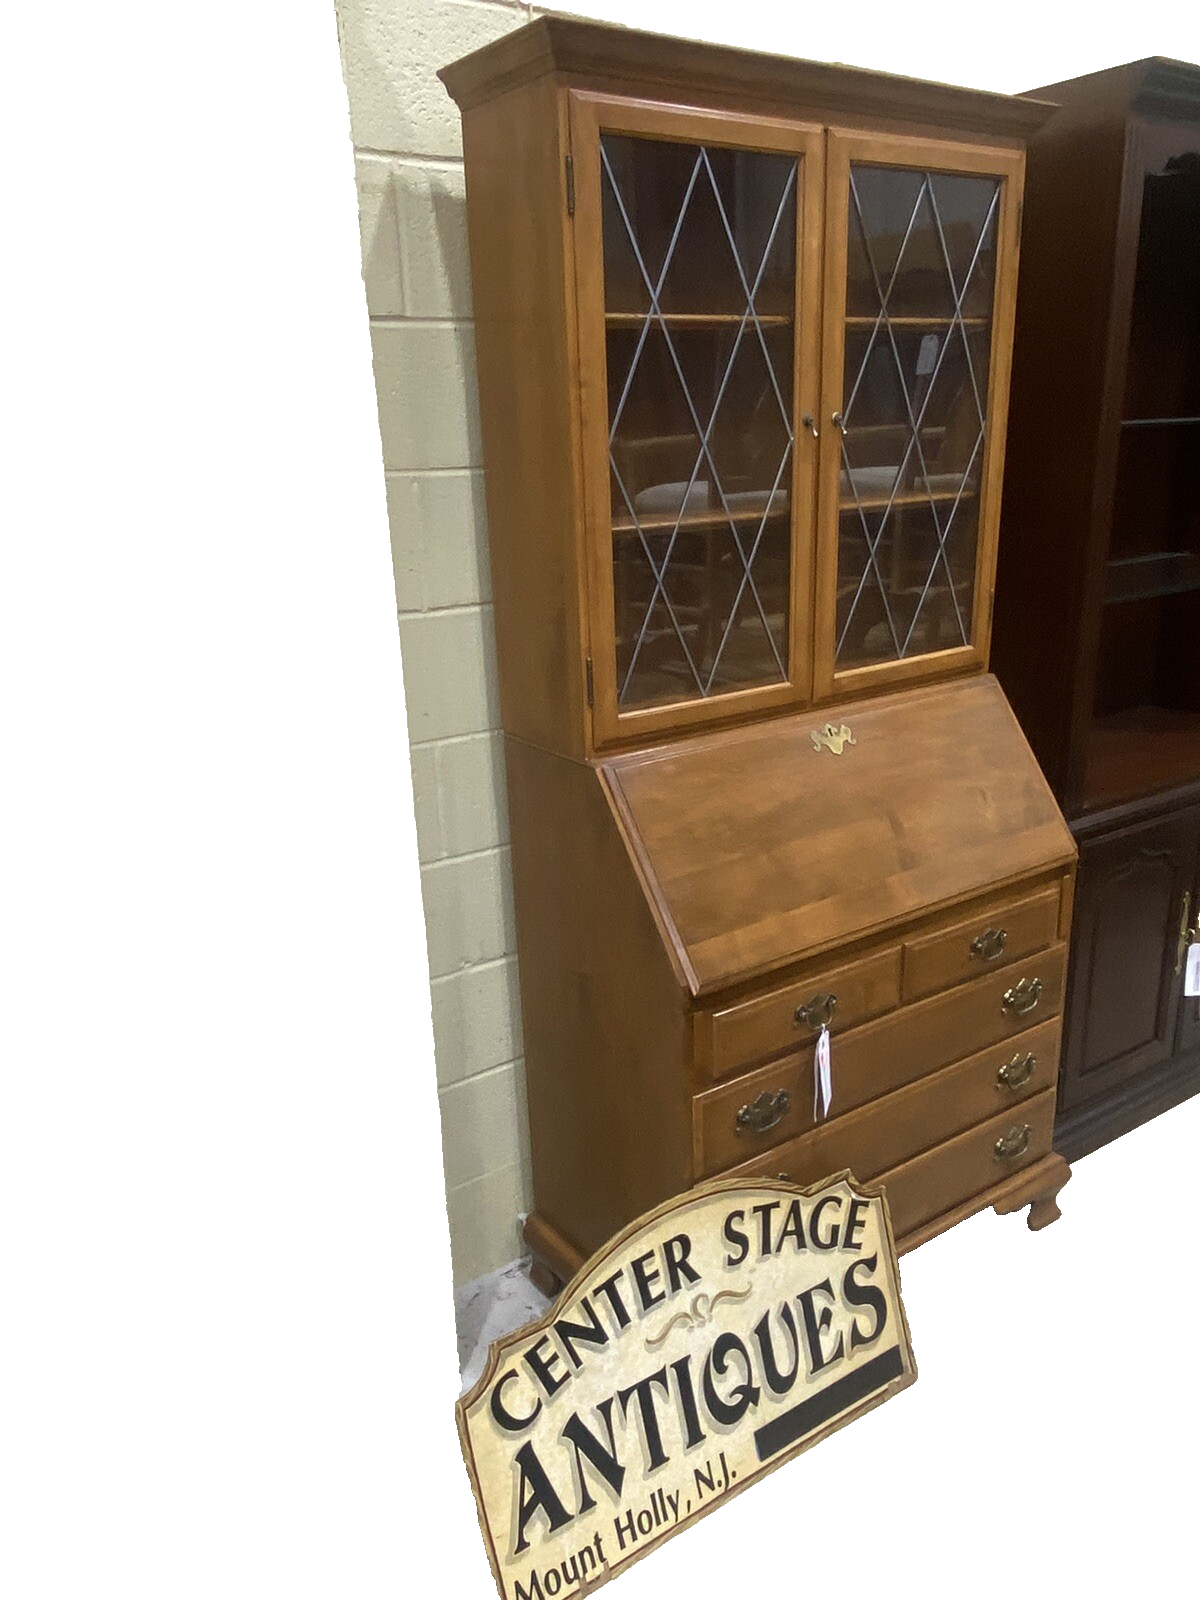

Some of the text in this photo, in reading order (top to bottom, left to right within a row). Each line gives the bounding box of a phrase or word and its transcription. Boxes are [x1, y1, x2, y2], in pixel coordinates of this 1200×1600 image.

[490, 1195, 870, 1431] CENTER STAGE
[514, 1252, 888, 1555] ANTIQUES
[513, 1452, 737, 1600] Mount Holly, N.J.
